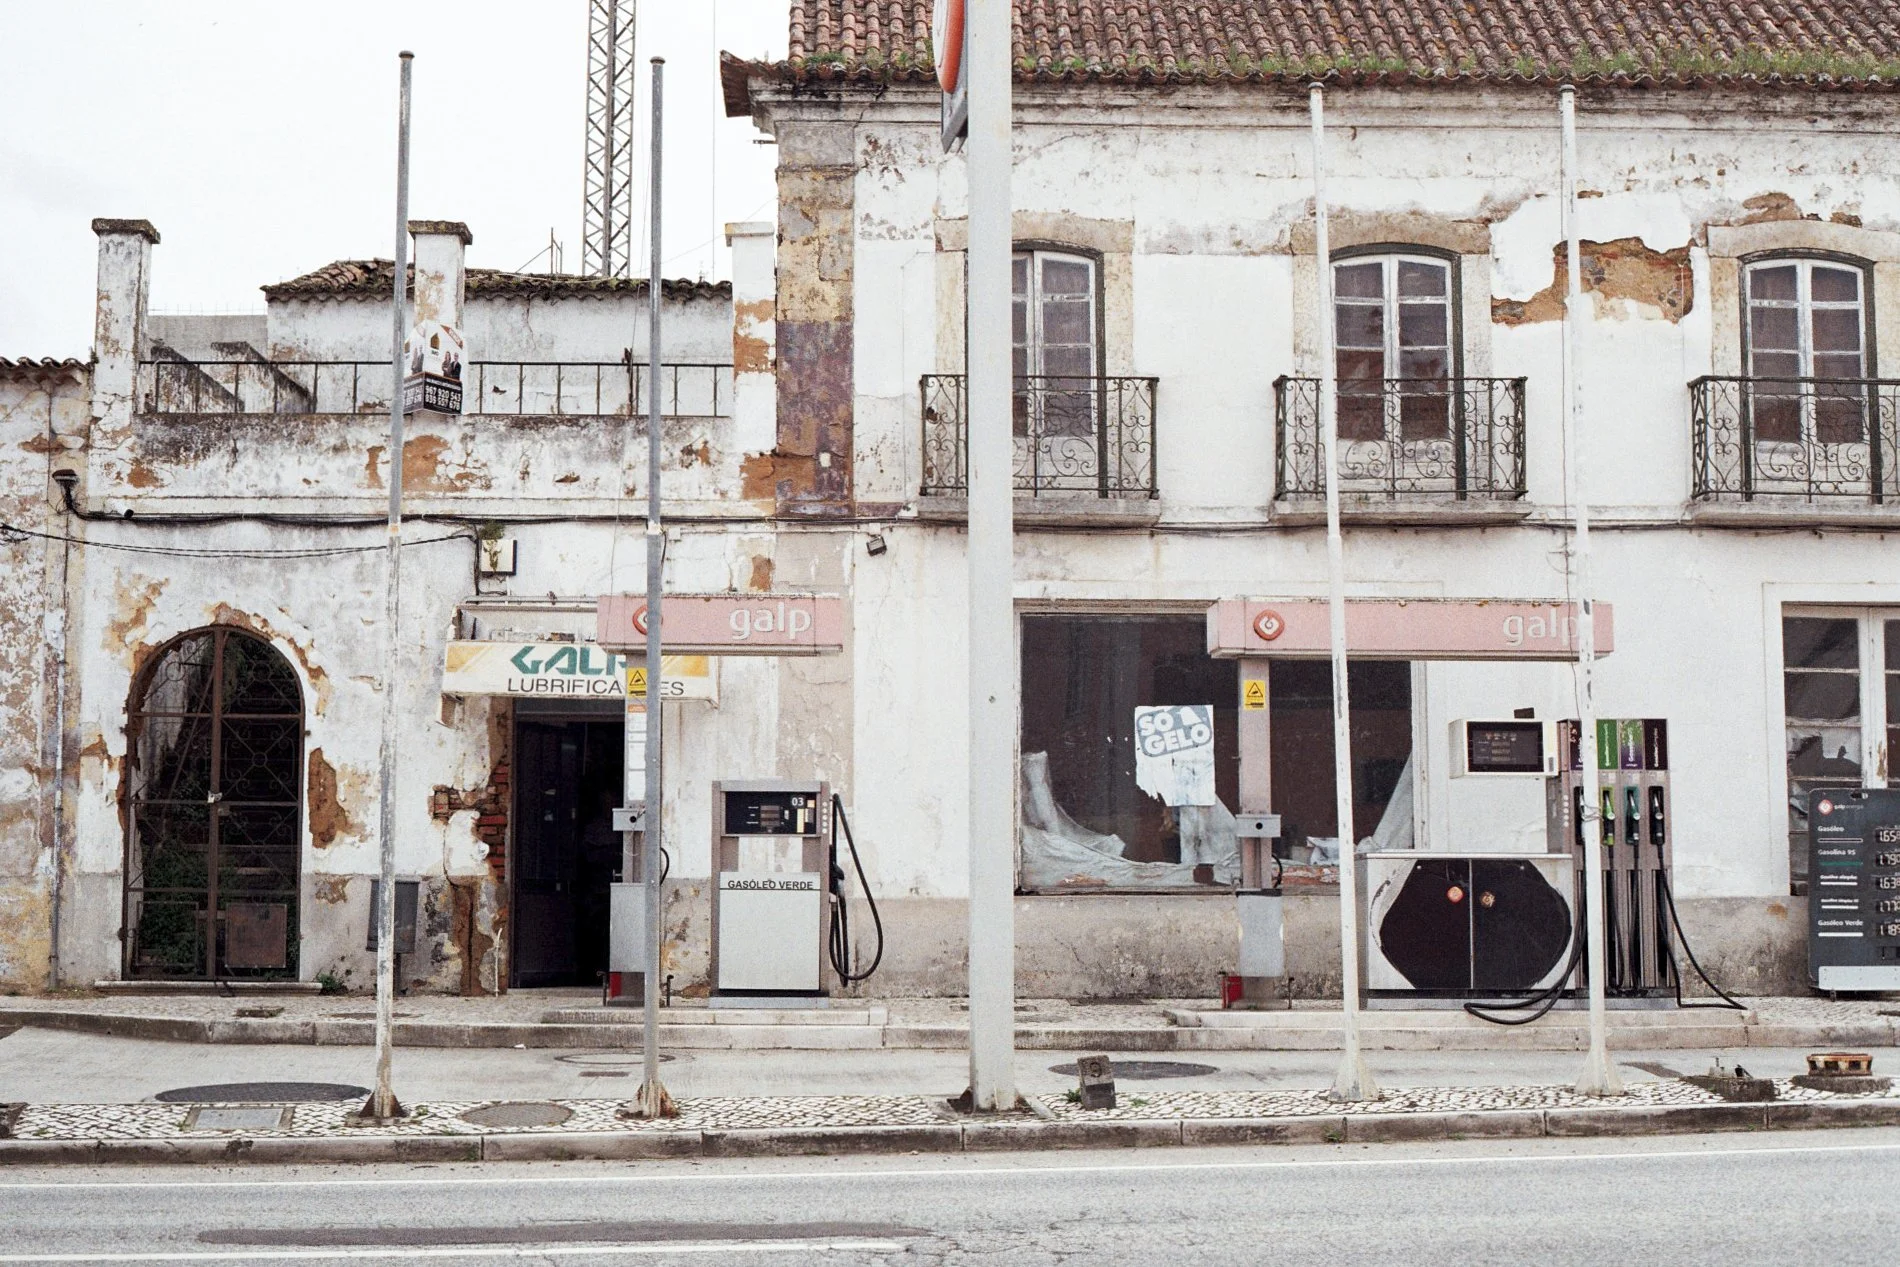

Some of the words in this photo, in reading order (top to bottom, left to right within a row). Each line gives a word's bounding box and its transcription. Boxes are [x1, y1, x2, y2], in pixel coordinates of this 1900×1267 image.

[729, 602, 812, 640] galp
[1503, 608, 1579, 647] galp
[508, 678, 684, 696] LUBRIFICAES
[1144, 723, 1211, 755] GELO
[791, 797, 804, 806] 03
[779, 880, 814, 890] VERDE
